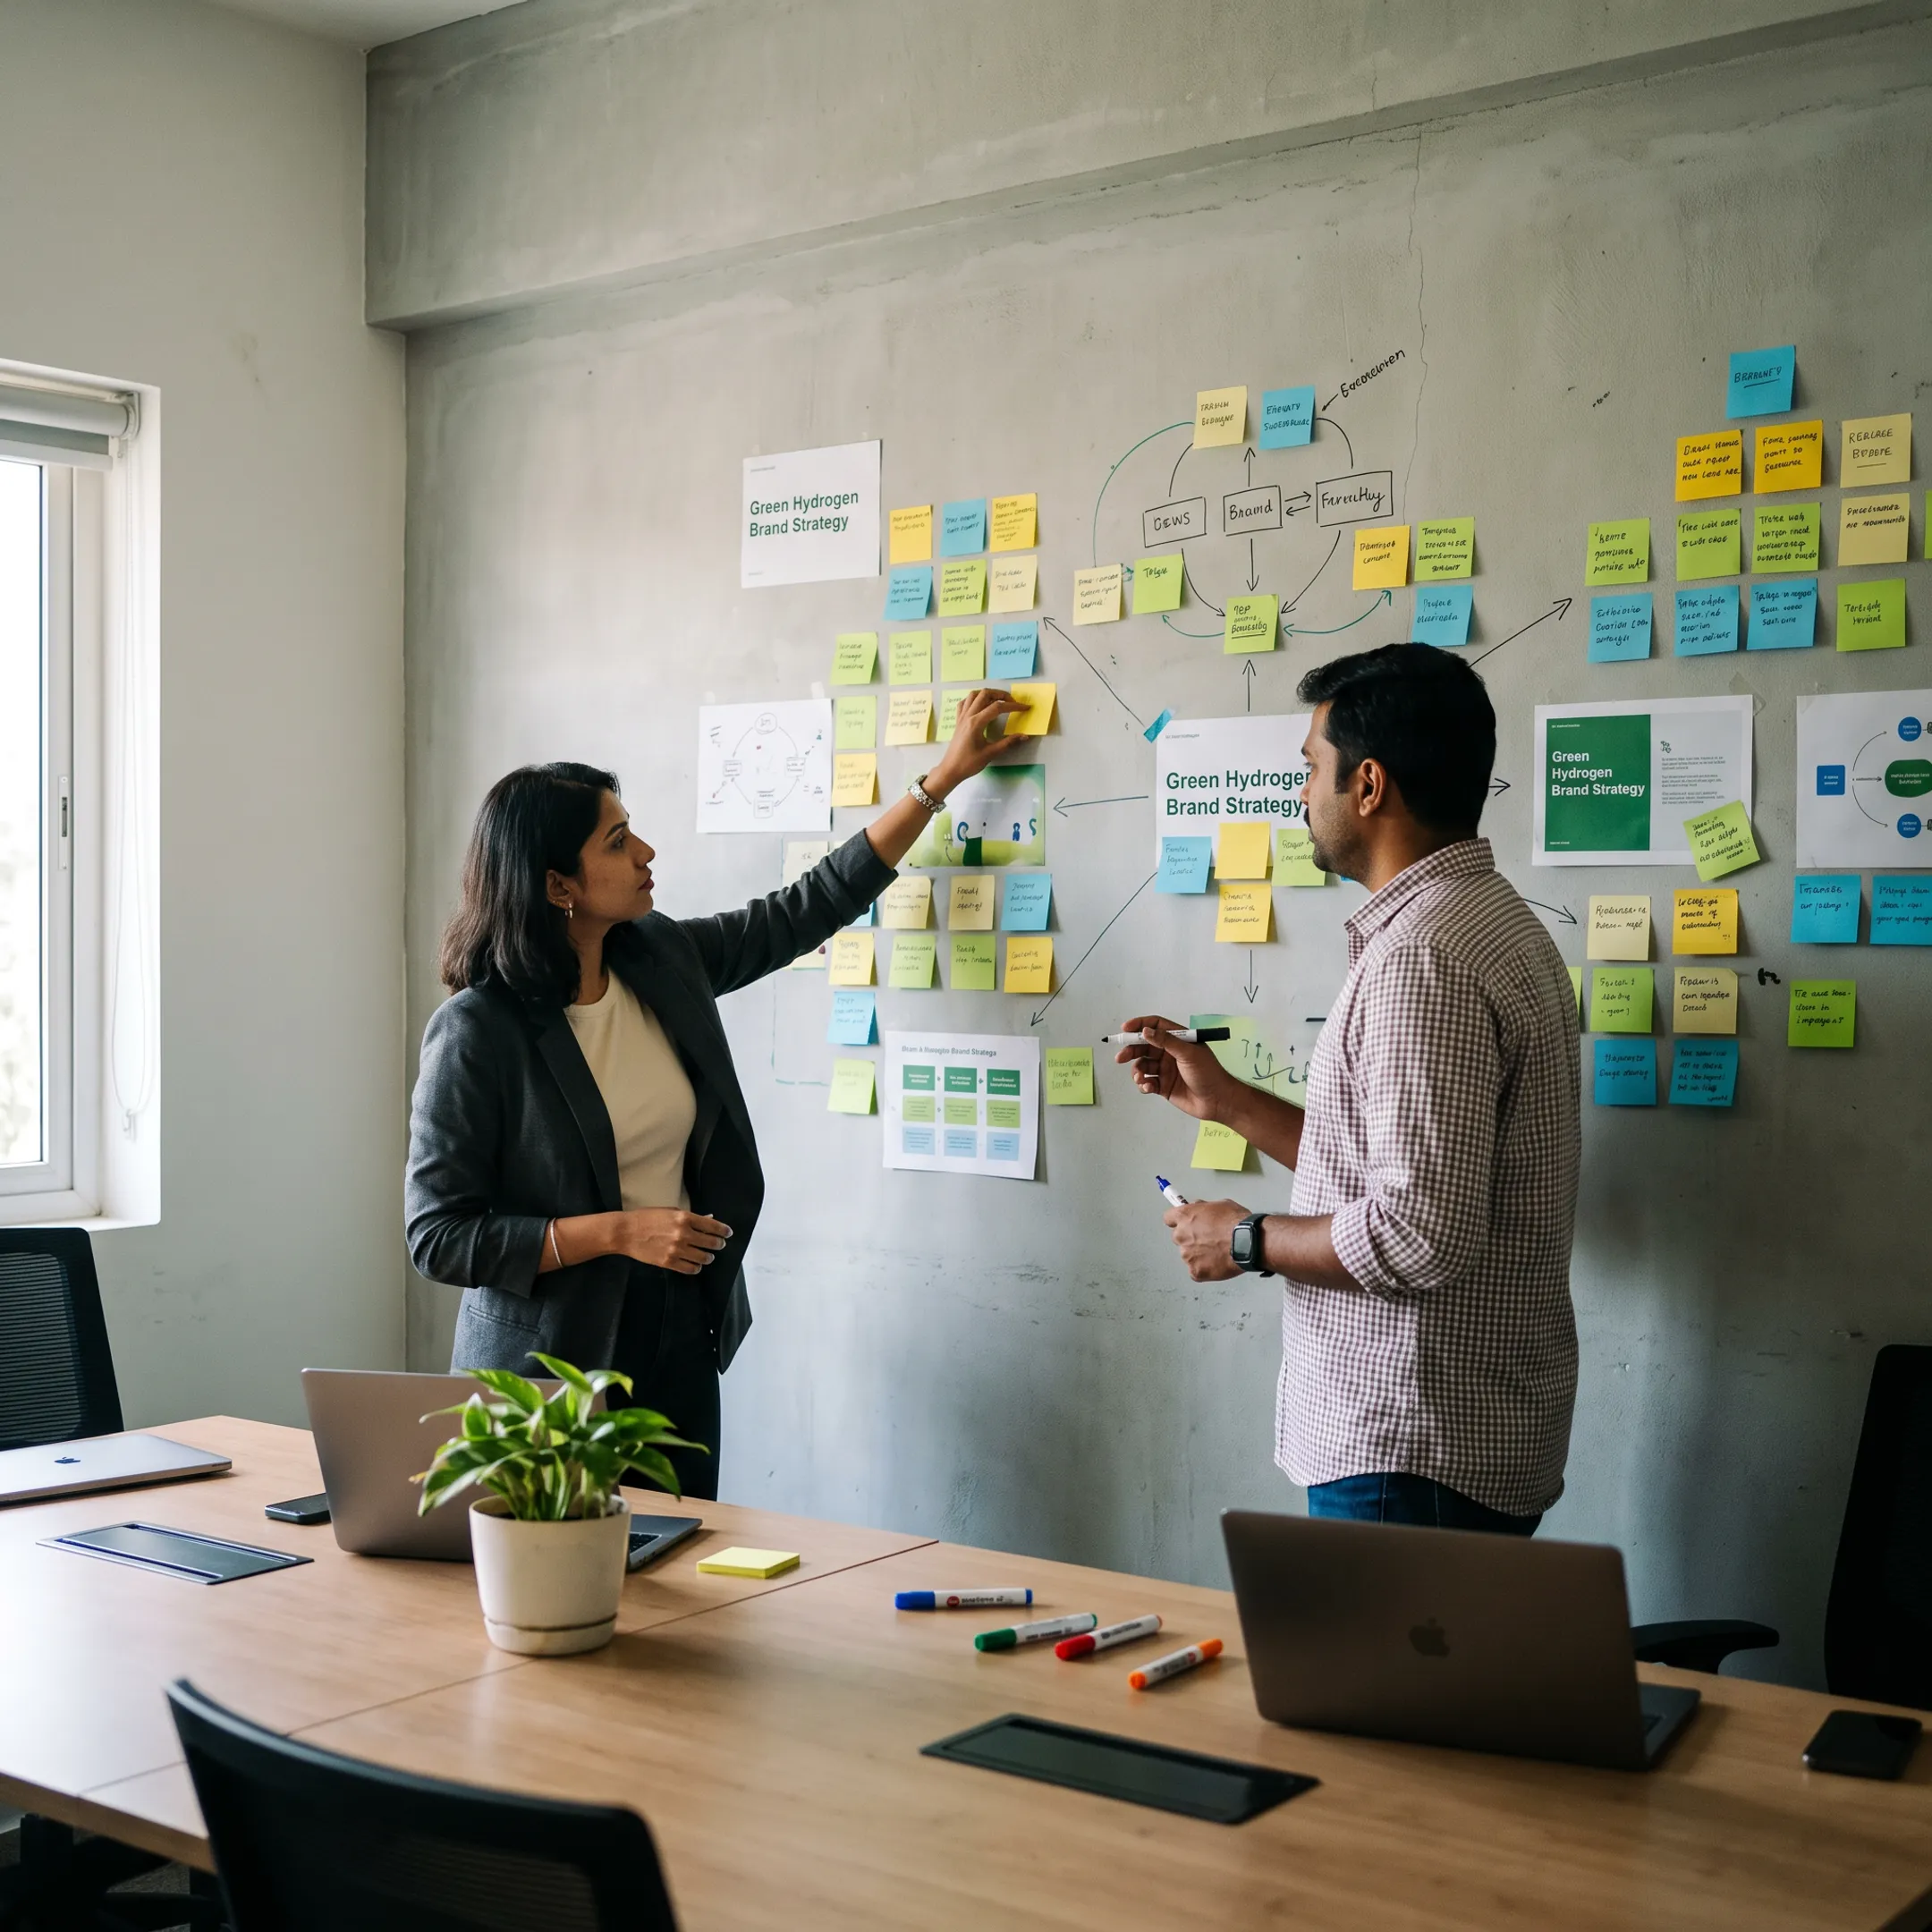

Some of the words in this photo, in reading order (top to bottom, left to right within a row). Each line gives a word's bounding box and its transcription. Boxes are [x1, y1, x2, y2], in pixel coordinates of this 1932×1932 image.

[750, 501, 789, 515] Green
[793, 493, 859, 513] Hydrogen
[750, 520, 788, 537] Brand
[792, 516, 849, 532] Strategy
[1552, 751, 1589, 762] Green
[1166, 772, 1219, 789] Green
[1552, 768, 1613, 781] Hydrogen
[1551, 784, 1589, 796] Brand
[1592, 784, 1645, 797] Strategy
[1166, 798, 1219, 815] Brand
[1225, 797, 1302, 818] Strategy
